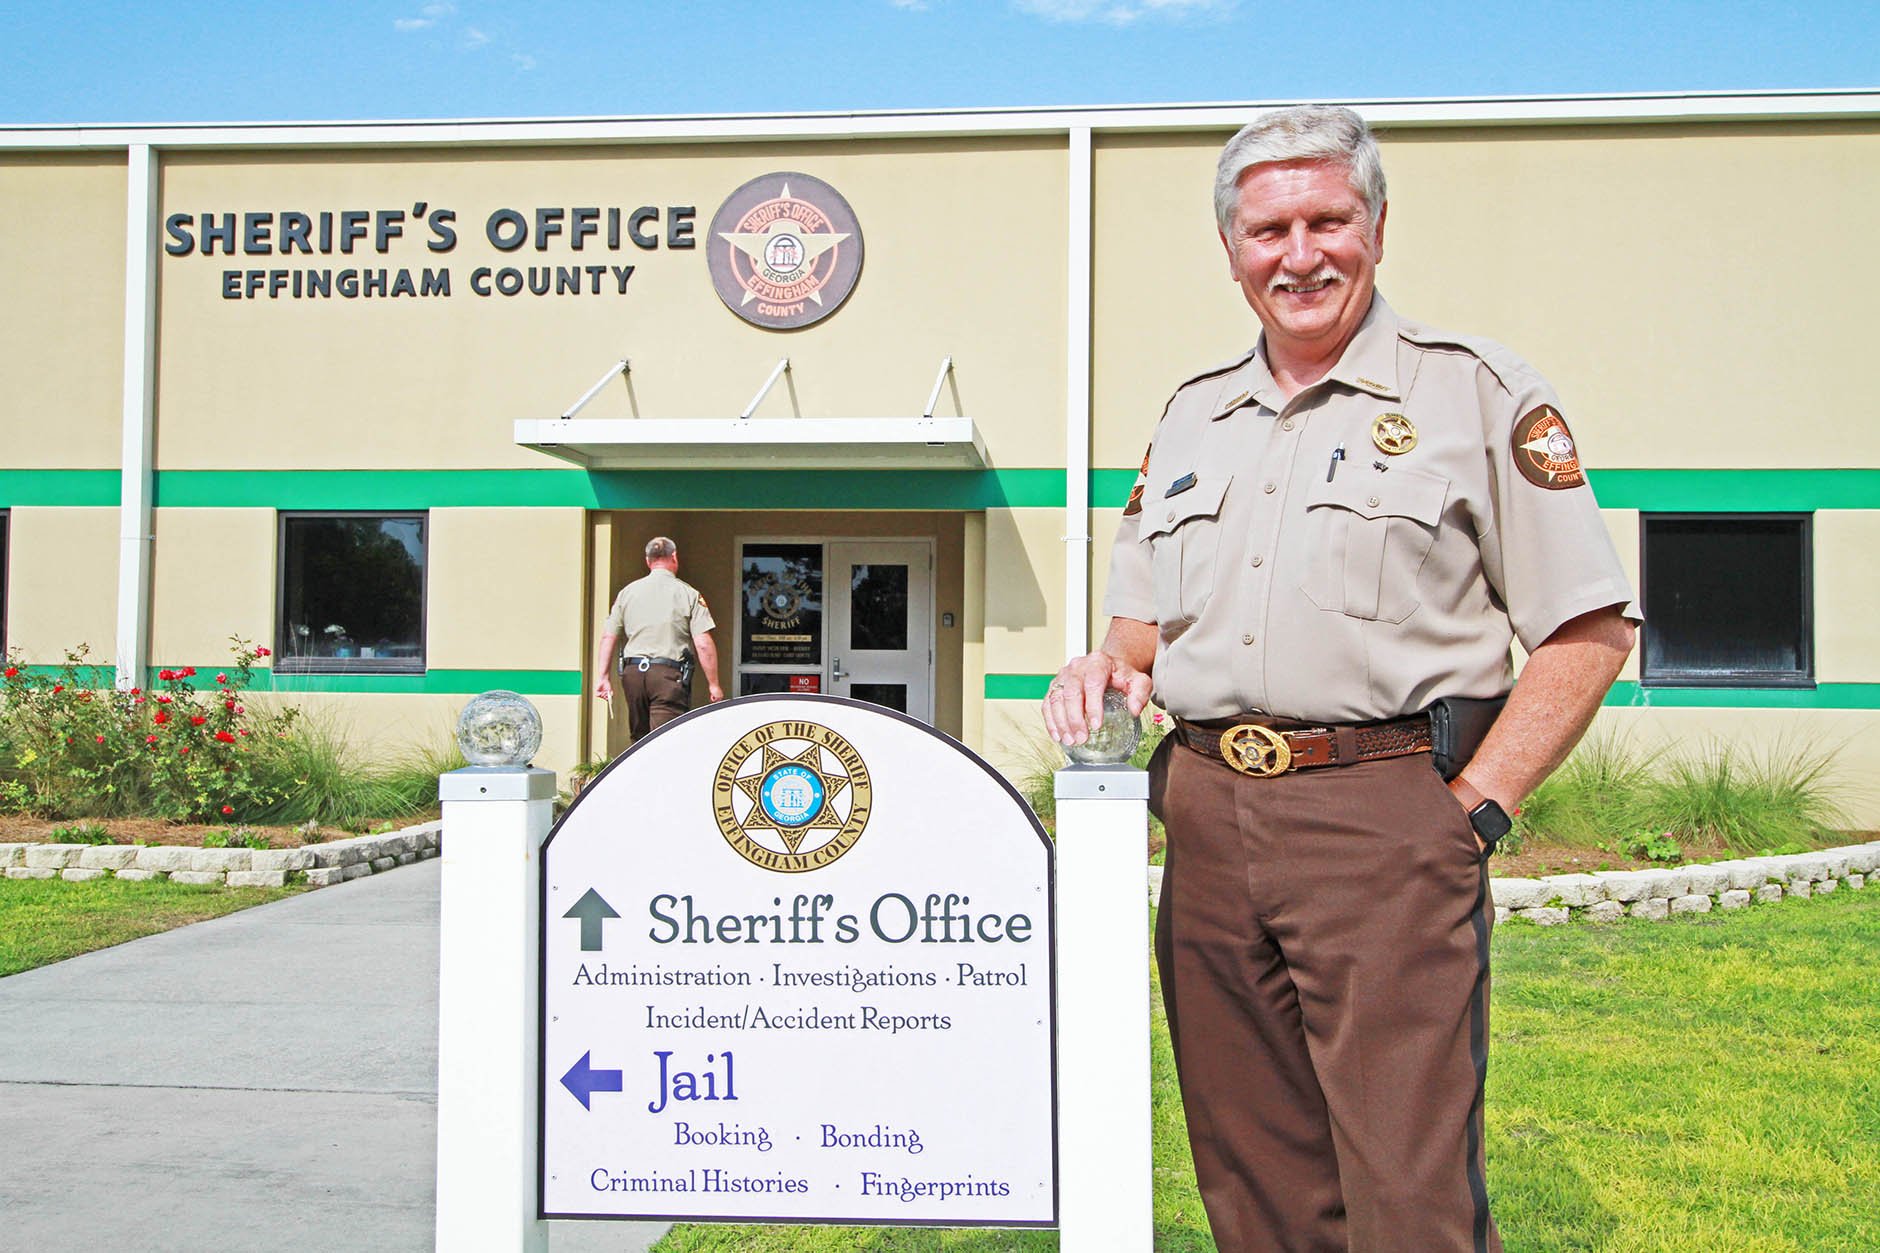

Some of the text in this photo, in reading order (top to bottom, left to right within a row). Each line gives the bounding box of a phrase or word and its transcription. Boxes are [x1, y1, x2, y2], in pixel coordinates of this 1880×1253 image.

[165, 202, 696, 256] SHERIFF'S OFFICE
[743, 202, 825, 233] SHERIFF'S OFFICE
[222, 265, 635, 299] EFFINGHAM COUNTY
[747, 275, 819, 300] EFFINGHAM
[762, 269, 806, 283] GEORGIA
[757, 302, 805, 317] COUNTY
[1542, 460, 1578, 471] EFFING
[1557, 472, 1583, 482] COUNT
[762, 616, 800, 629] SHERIFF
[798, 678, 810, 686] NO
[717, 722, 869, 793] OFFICE OF THE SHERIFF
[773, 768, 813, 781] STATE OF
[773, 811, 809, 823] GEORGIA
[717, 802, 869, 870] EFFINGHAM COUNTY
[649, 893, 1032, 944] Sheriff's Office
[572, 963, 1028, 992] Administration Investigations Patrol
[645, 1004, 952, 1034] Incident/Accident Reports
[648, 1051, 738, 1113] Jail
[674, 1122, 924, 1154] Booking Bonding
[590, 1168, 1010, 1202] Criminal Histories Fingerprints
